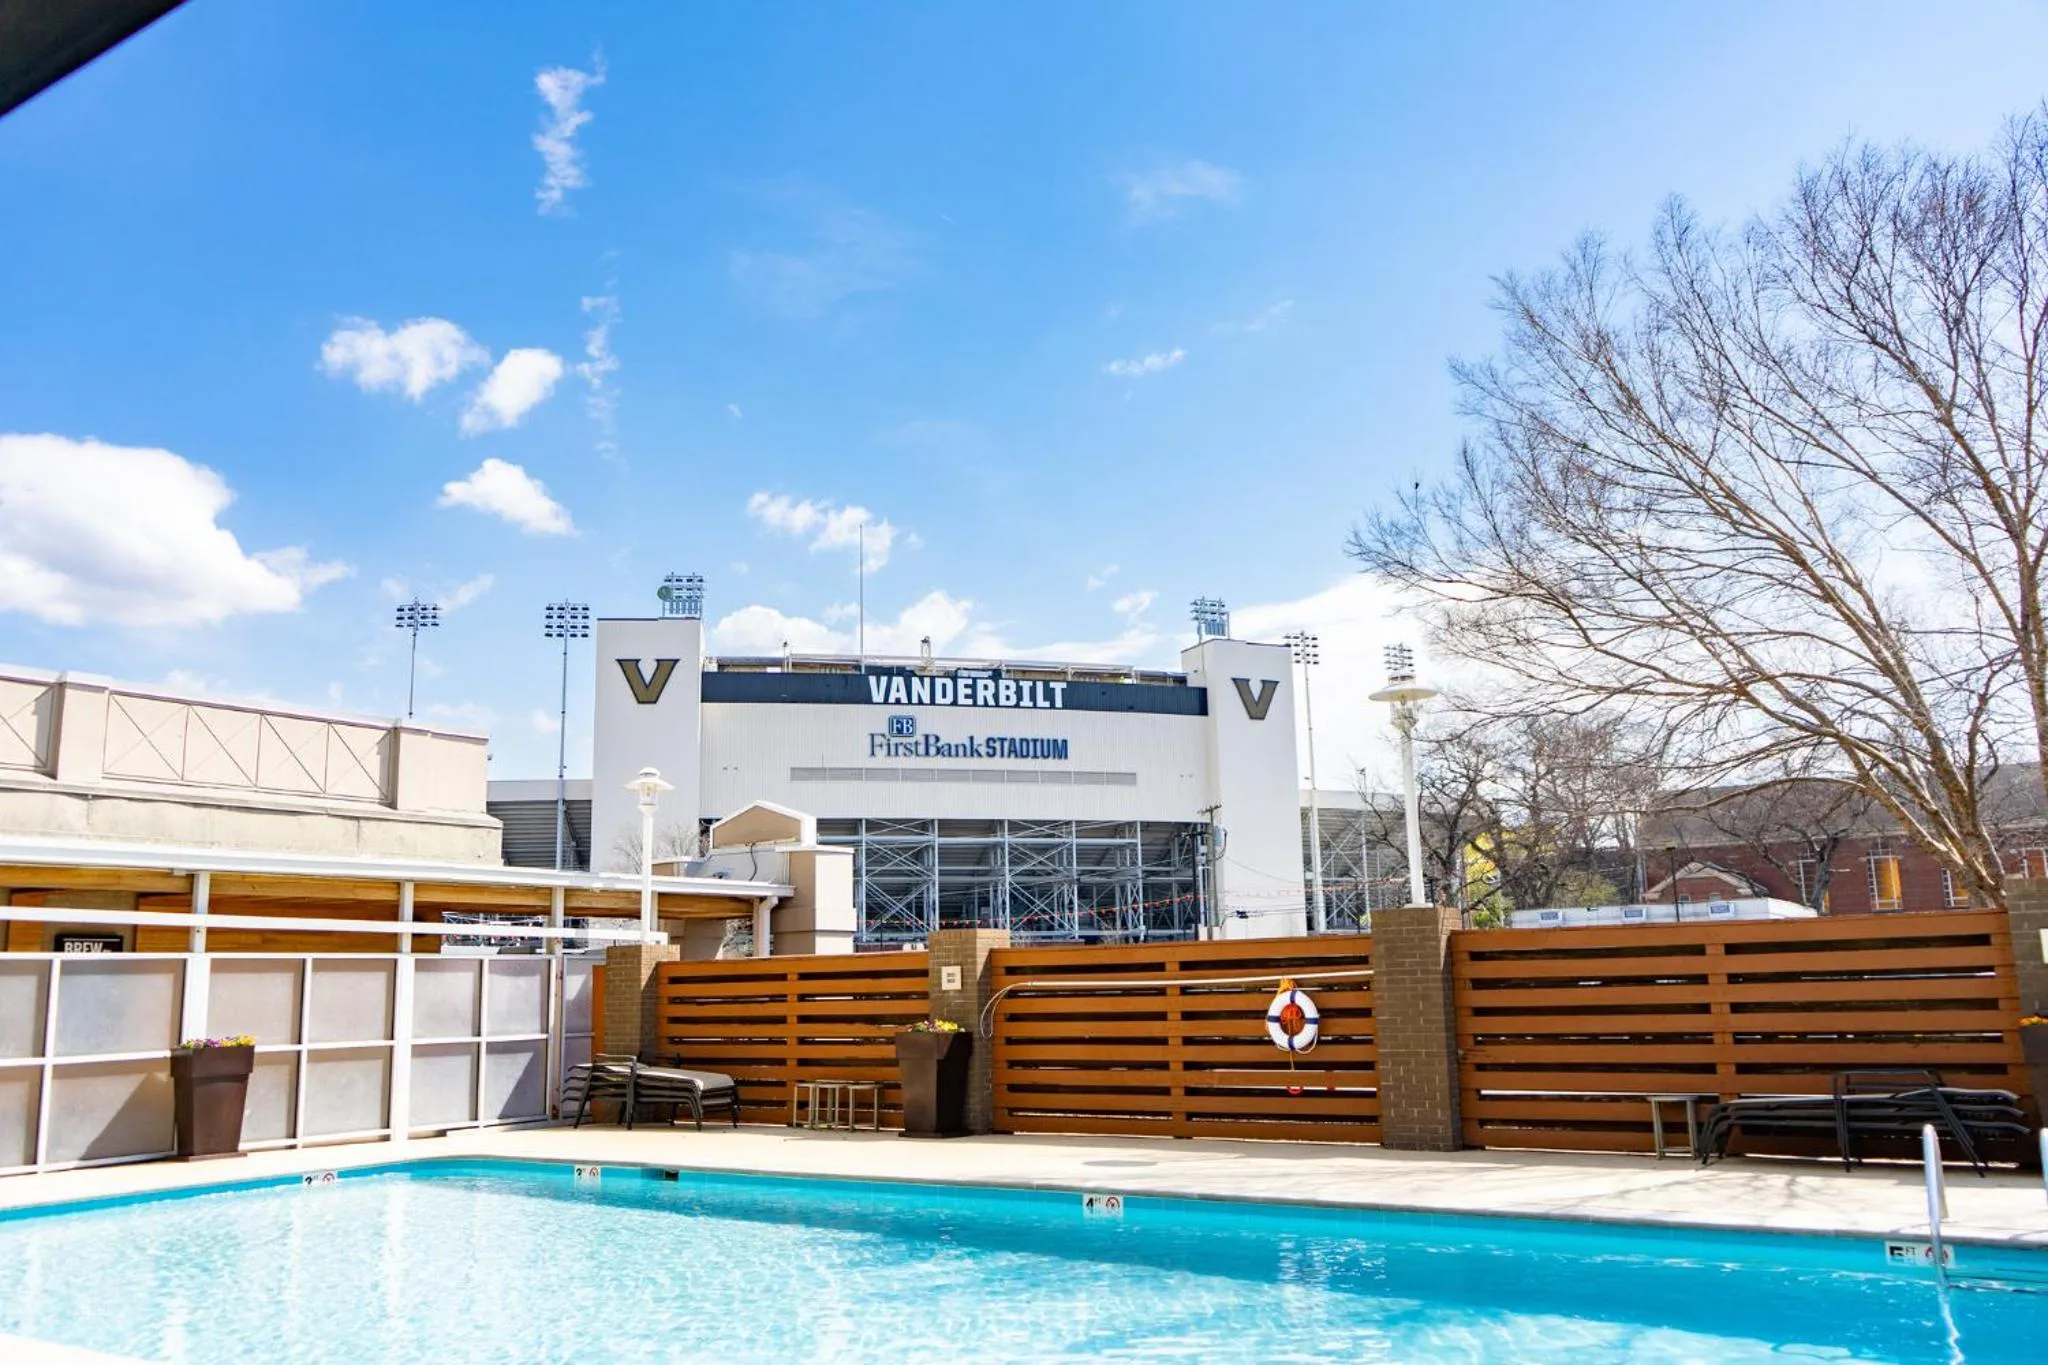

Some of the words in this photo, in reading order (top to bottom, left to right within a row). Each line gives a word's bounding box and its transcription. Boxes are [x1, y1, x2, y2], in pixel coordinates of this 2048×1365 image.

[615, 658, 681, 704] V
[868, 675, 1067, 708] VANDERBILT
[1230, 677, 1280, 720] V
[869, 733, 985, 758] FirstBank
[985, 737, 1069, 760] STADIUM
[64, 941, 103, 953] BREW
